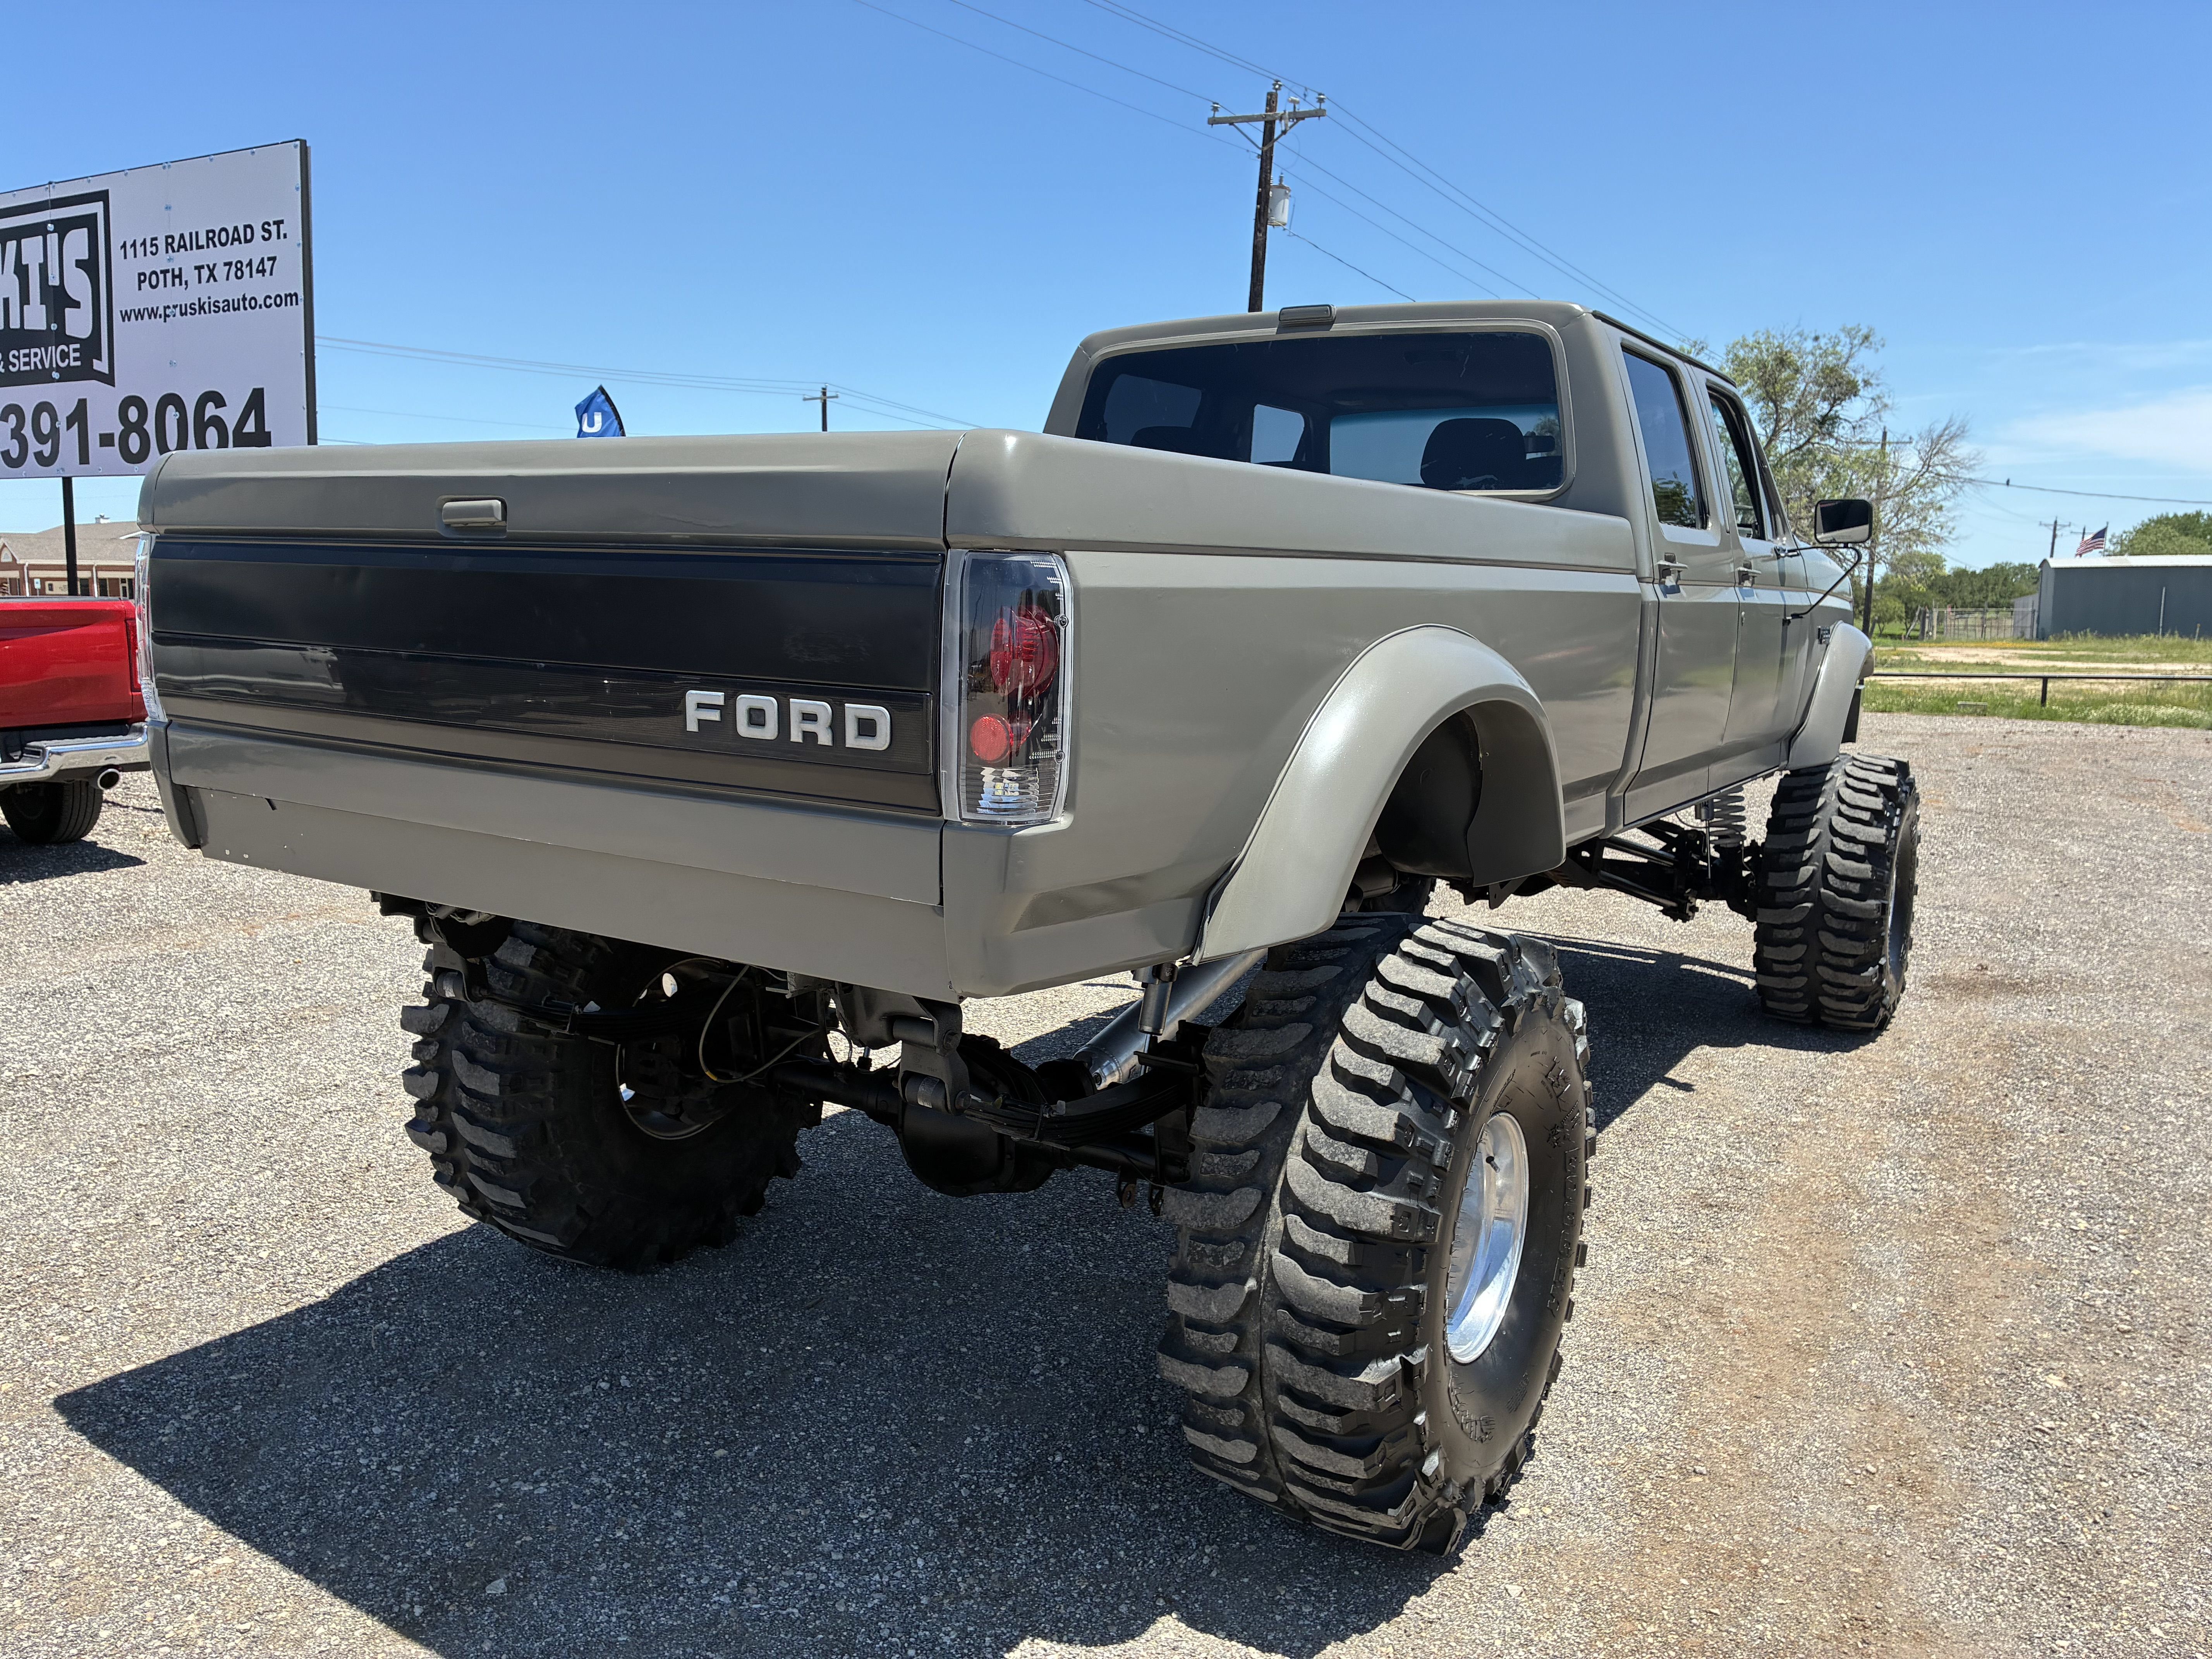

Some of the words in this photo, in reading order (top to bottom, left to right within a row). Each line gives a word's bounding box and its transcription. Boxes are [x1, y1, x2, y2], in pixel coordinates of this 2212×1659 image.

[120, 237, 158, 259] 1115
[165, 224, 254, 254] RAILROAD
[261, 219, 287, 241] ST.
[137, 266, 188, 290] POTH,
[194, 263, 218, 284] TX
[223, 256, 277, 281] 78147
[120, 291, 299, 323] www.pruskisauto.com
[9, 343, 81, 373] SERVICE
[0, 387, 271, 468] 391-8064
[686, 690, 891, 751] FORD
